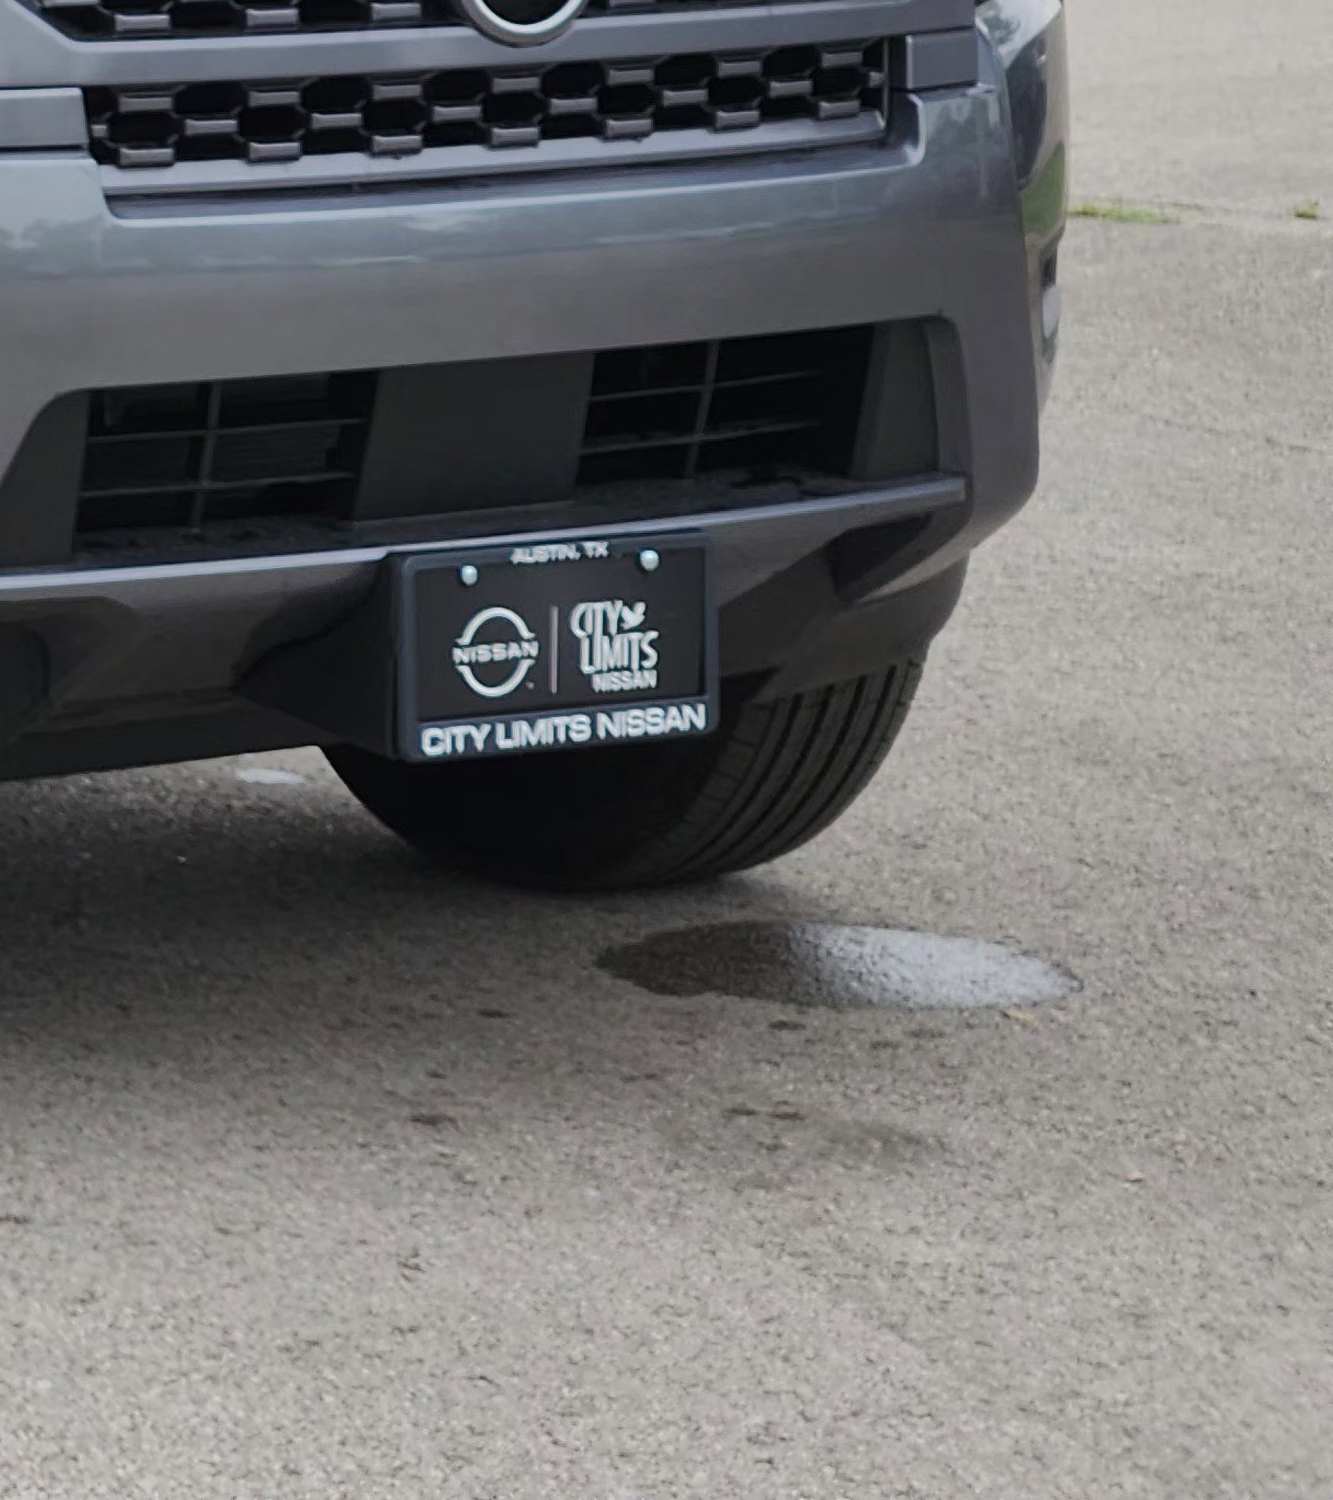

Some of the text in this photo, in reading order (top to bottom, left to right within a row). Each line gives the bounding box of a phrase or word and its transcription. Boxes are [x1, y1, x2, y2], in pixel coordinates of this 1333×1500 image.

[582, 541, 609, 557] TX
[570, 599, 623, 638] CITY
[451, 640, 539, 664] NISSAN
[581, 631, 660, 674] LIMITS
[591, 670, 658, 693] NISSAN
[421, 703, 707, 756] CITY LIMITS NISSAN
